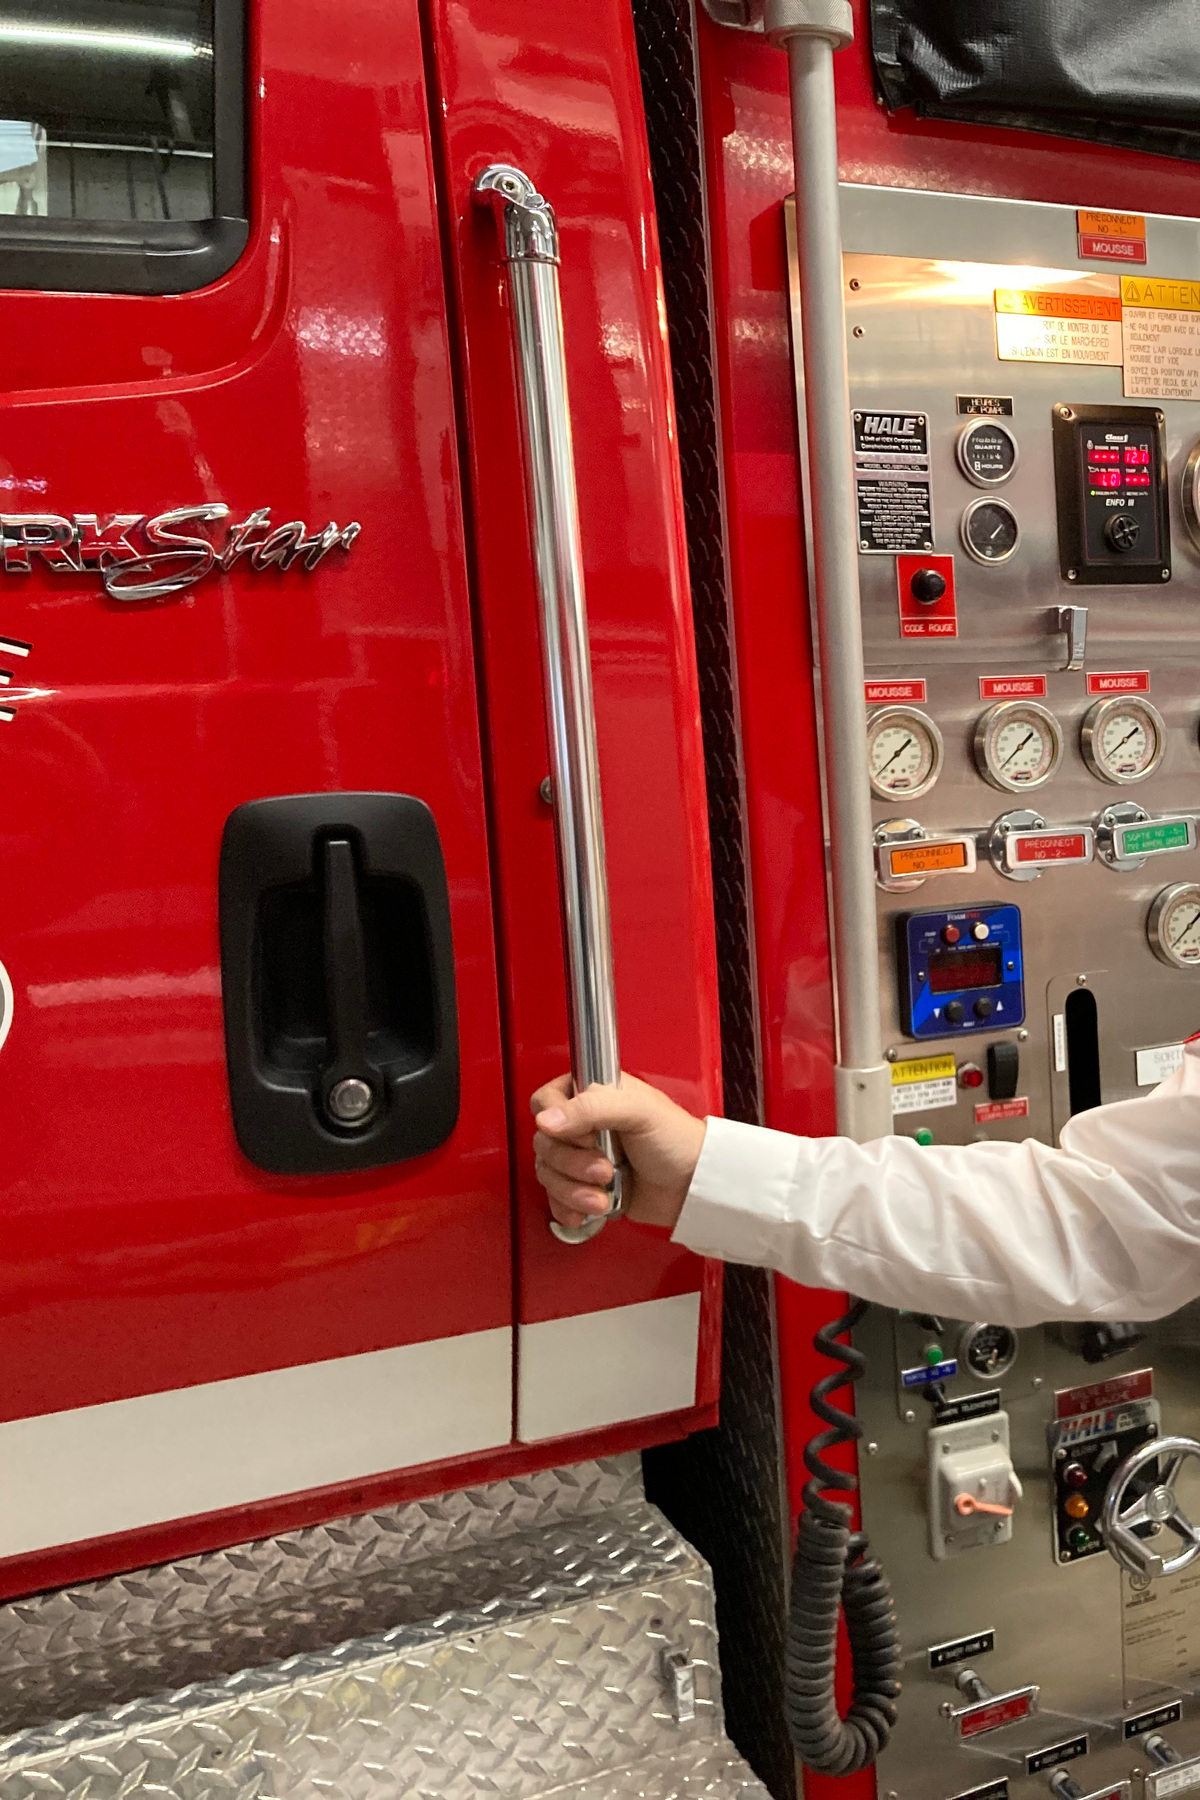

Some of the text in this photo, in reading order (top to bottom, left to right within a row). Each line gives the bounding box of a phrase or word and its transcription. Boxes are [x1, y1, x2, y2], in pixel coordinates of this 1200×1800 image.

[1098, 225, 1109, 233] NO
[1092, 242, 1135, 256] MOUSSE
[1022, 295, 1119, 317] AVERTISSEMENT
[1160, 368, 1185, 377] POSITION
[971, 398, 1000, 407] HEURES
[966, 405, 1005, 415] DE POMPE
[863, 416, 917, 436] HALE
[1105, 498, 1125, 507] ENFO
[904, 623, 955, 633] CODE ROUGE
[993, 682, 1035, 693] MOUSSE
[1099, 677, 1139, 689] MOUSSE
[868, 687, 913, 698] MOUSSE
[1127, 831, 1151, 842] SORTIE
[1155, 829, 1165, 838] NO
[1034, 850, 1047, 860] NO
[912, 860, 925, 870] NO
[892, 1060, 954, 1079] ATTENTION
